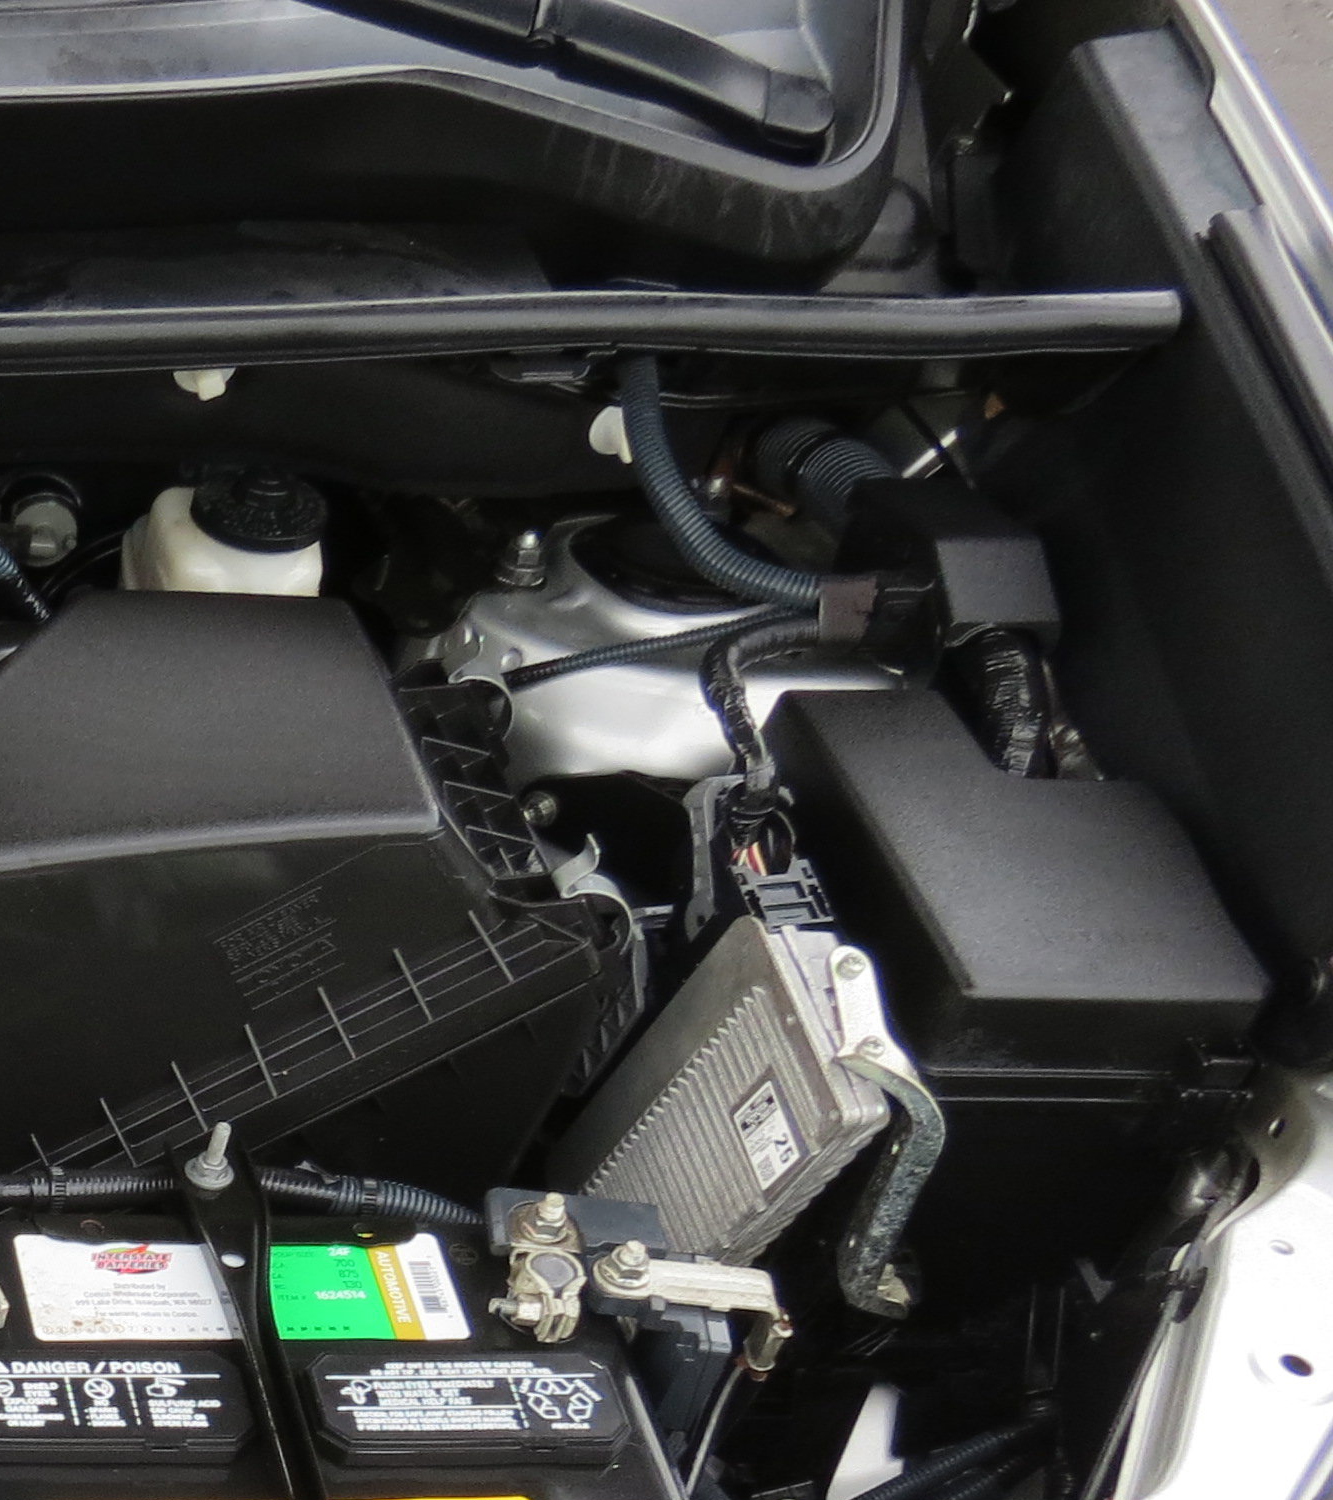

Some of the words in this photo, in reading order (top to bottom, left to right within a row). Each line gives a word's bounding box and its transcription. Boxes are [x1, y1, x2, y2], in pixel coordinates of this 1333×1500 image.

[92, 1252, 171, 1262] INTERSTATE
[96, 1260, 167, 1270] BATTERIES
[333, 1258, 356, 1268] 700
[375, 1250, 413, 1324] AUTOMOTIVE
[10, 1361, 90, 1374] DANGER
[109, 1361, 181, 1374] POISON
[197, 1399, 222, 1408] ACID
